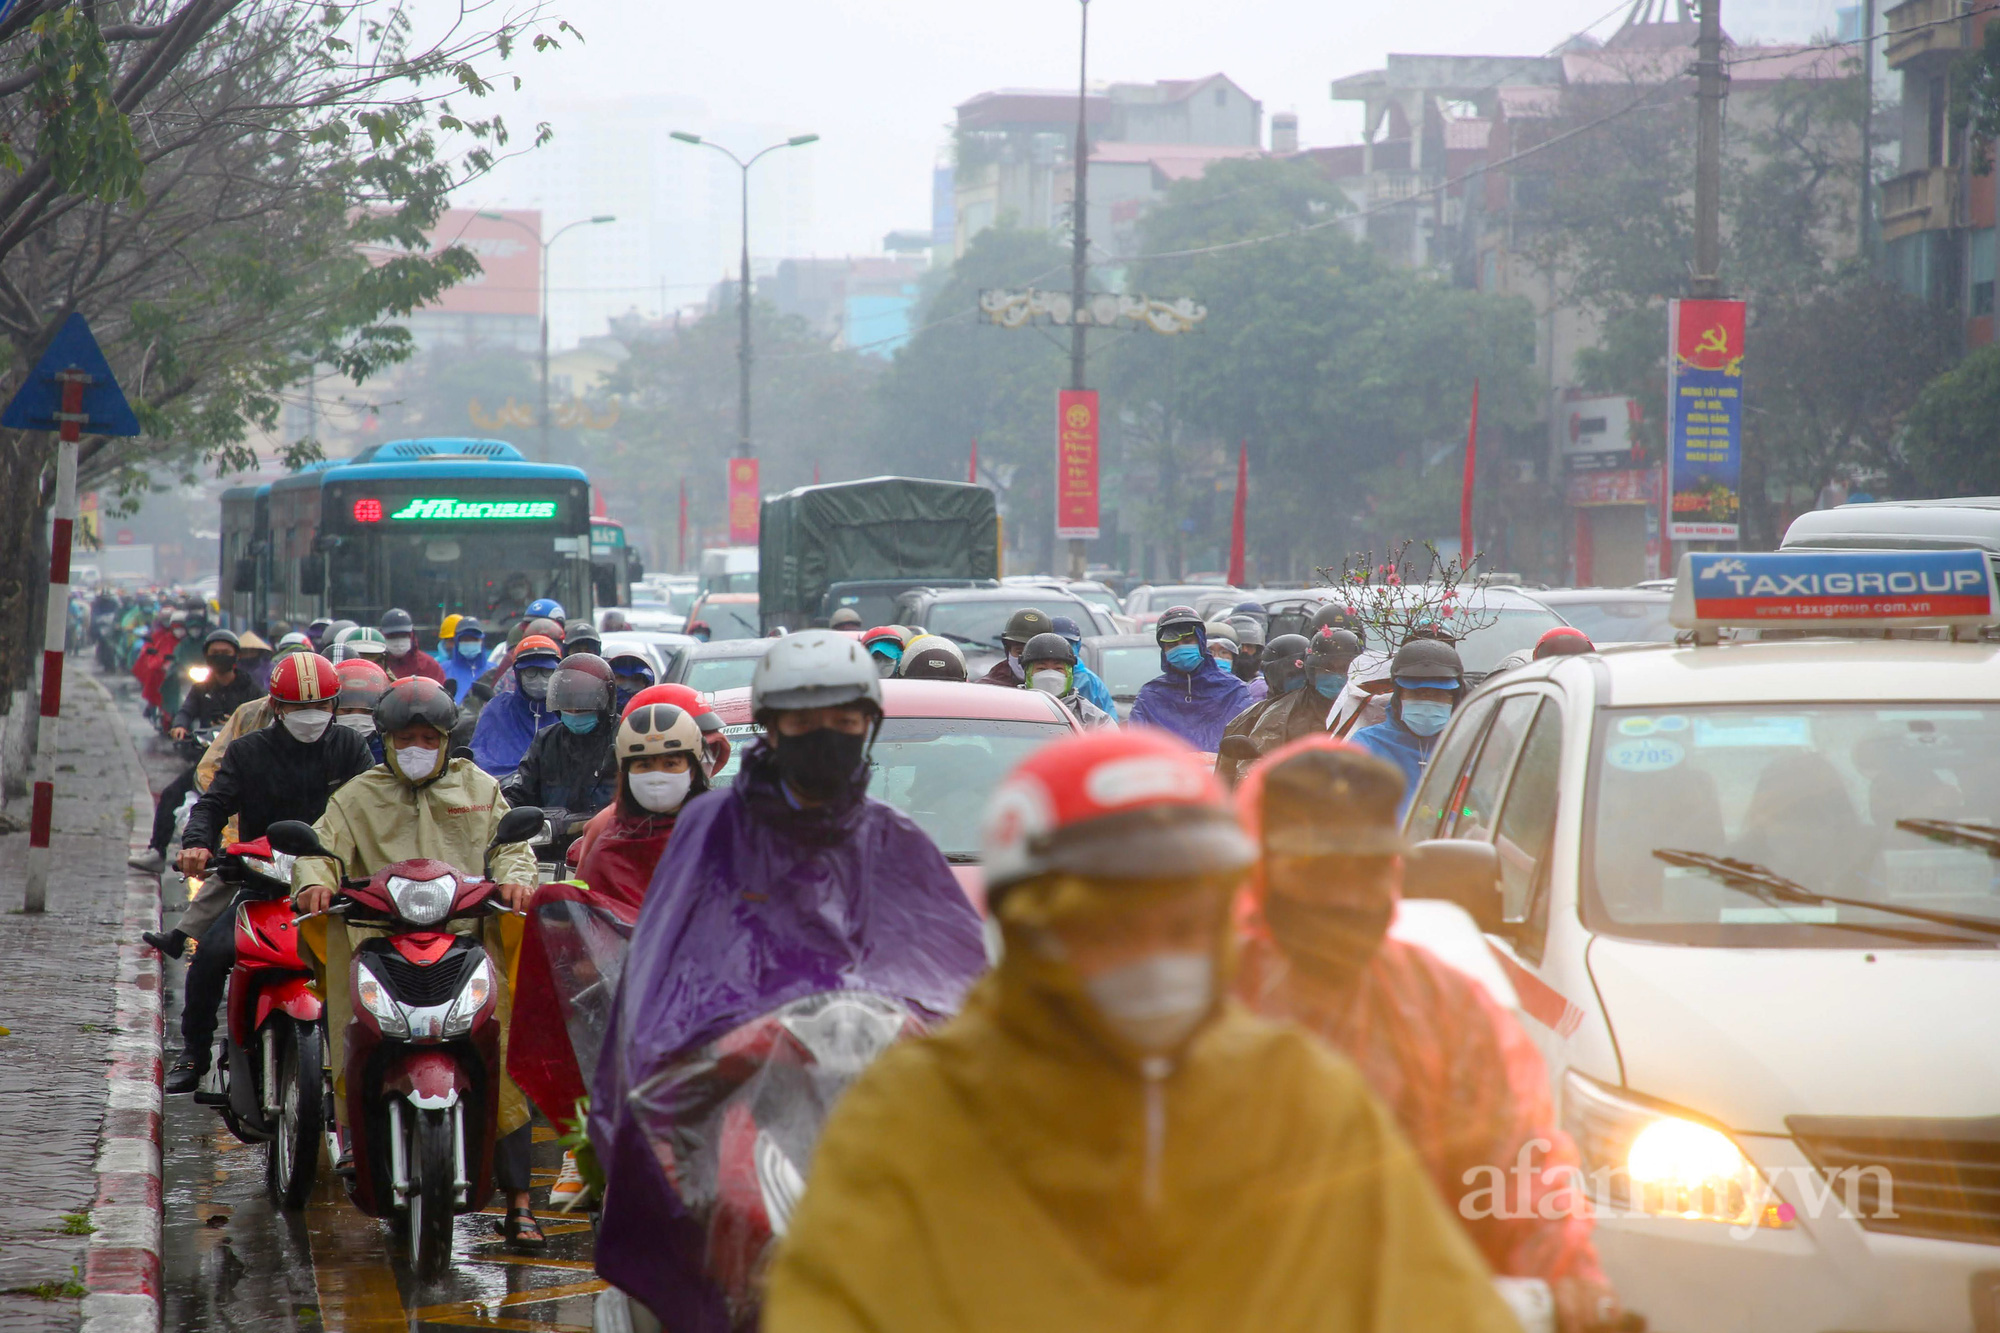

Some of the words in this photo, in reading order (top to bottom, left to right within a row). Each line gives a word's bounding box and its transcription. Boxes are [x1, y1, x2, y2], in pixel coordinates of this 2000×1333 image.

[1727, 569, 1982, 597] TAXIGROUP
[1755, 601, 1931, 617] www.taxigroup.com.vn
[1620, 749, 1674, 764] 2705
